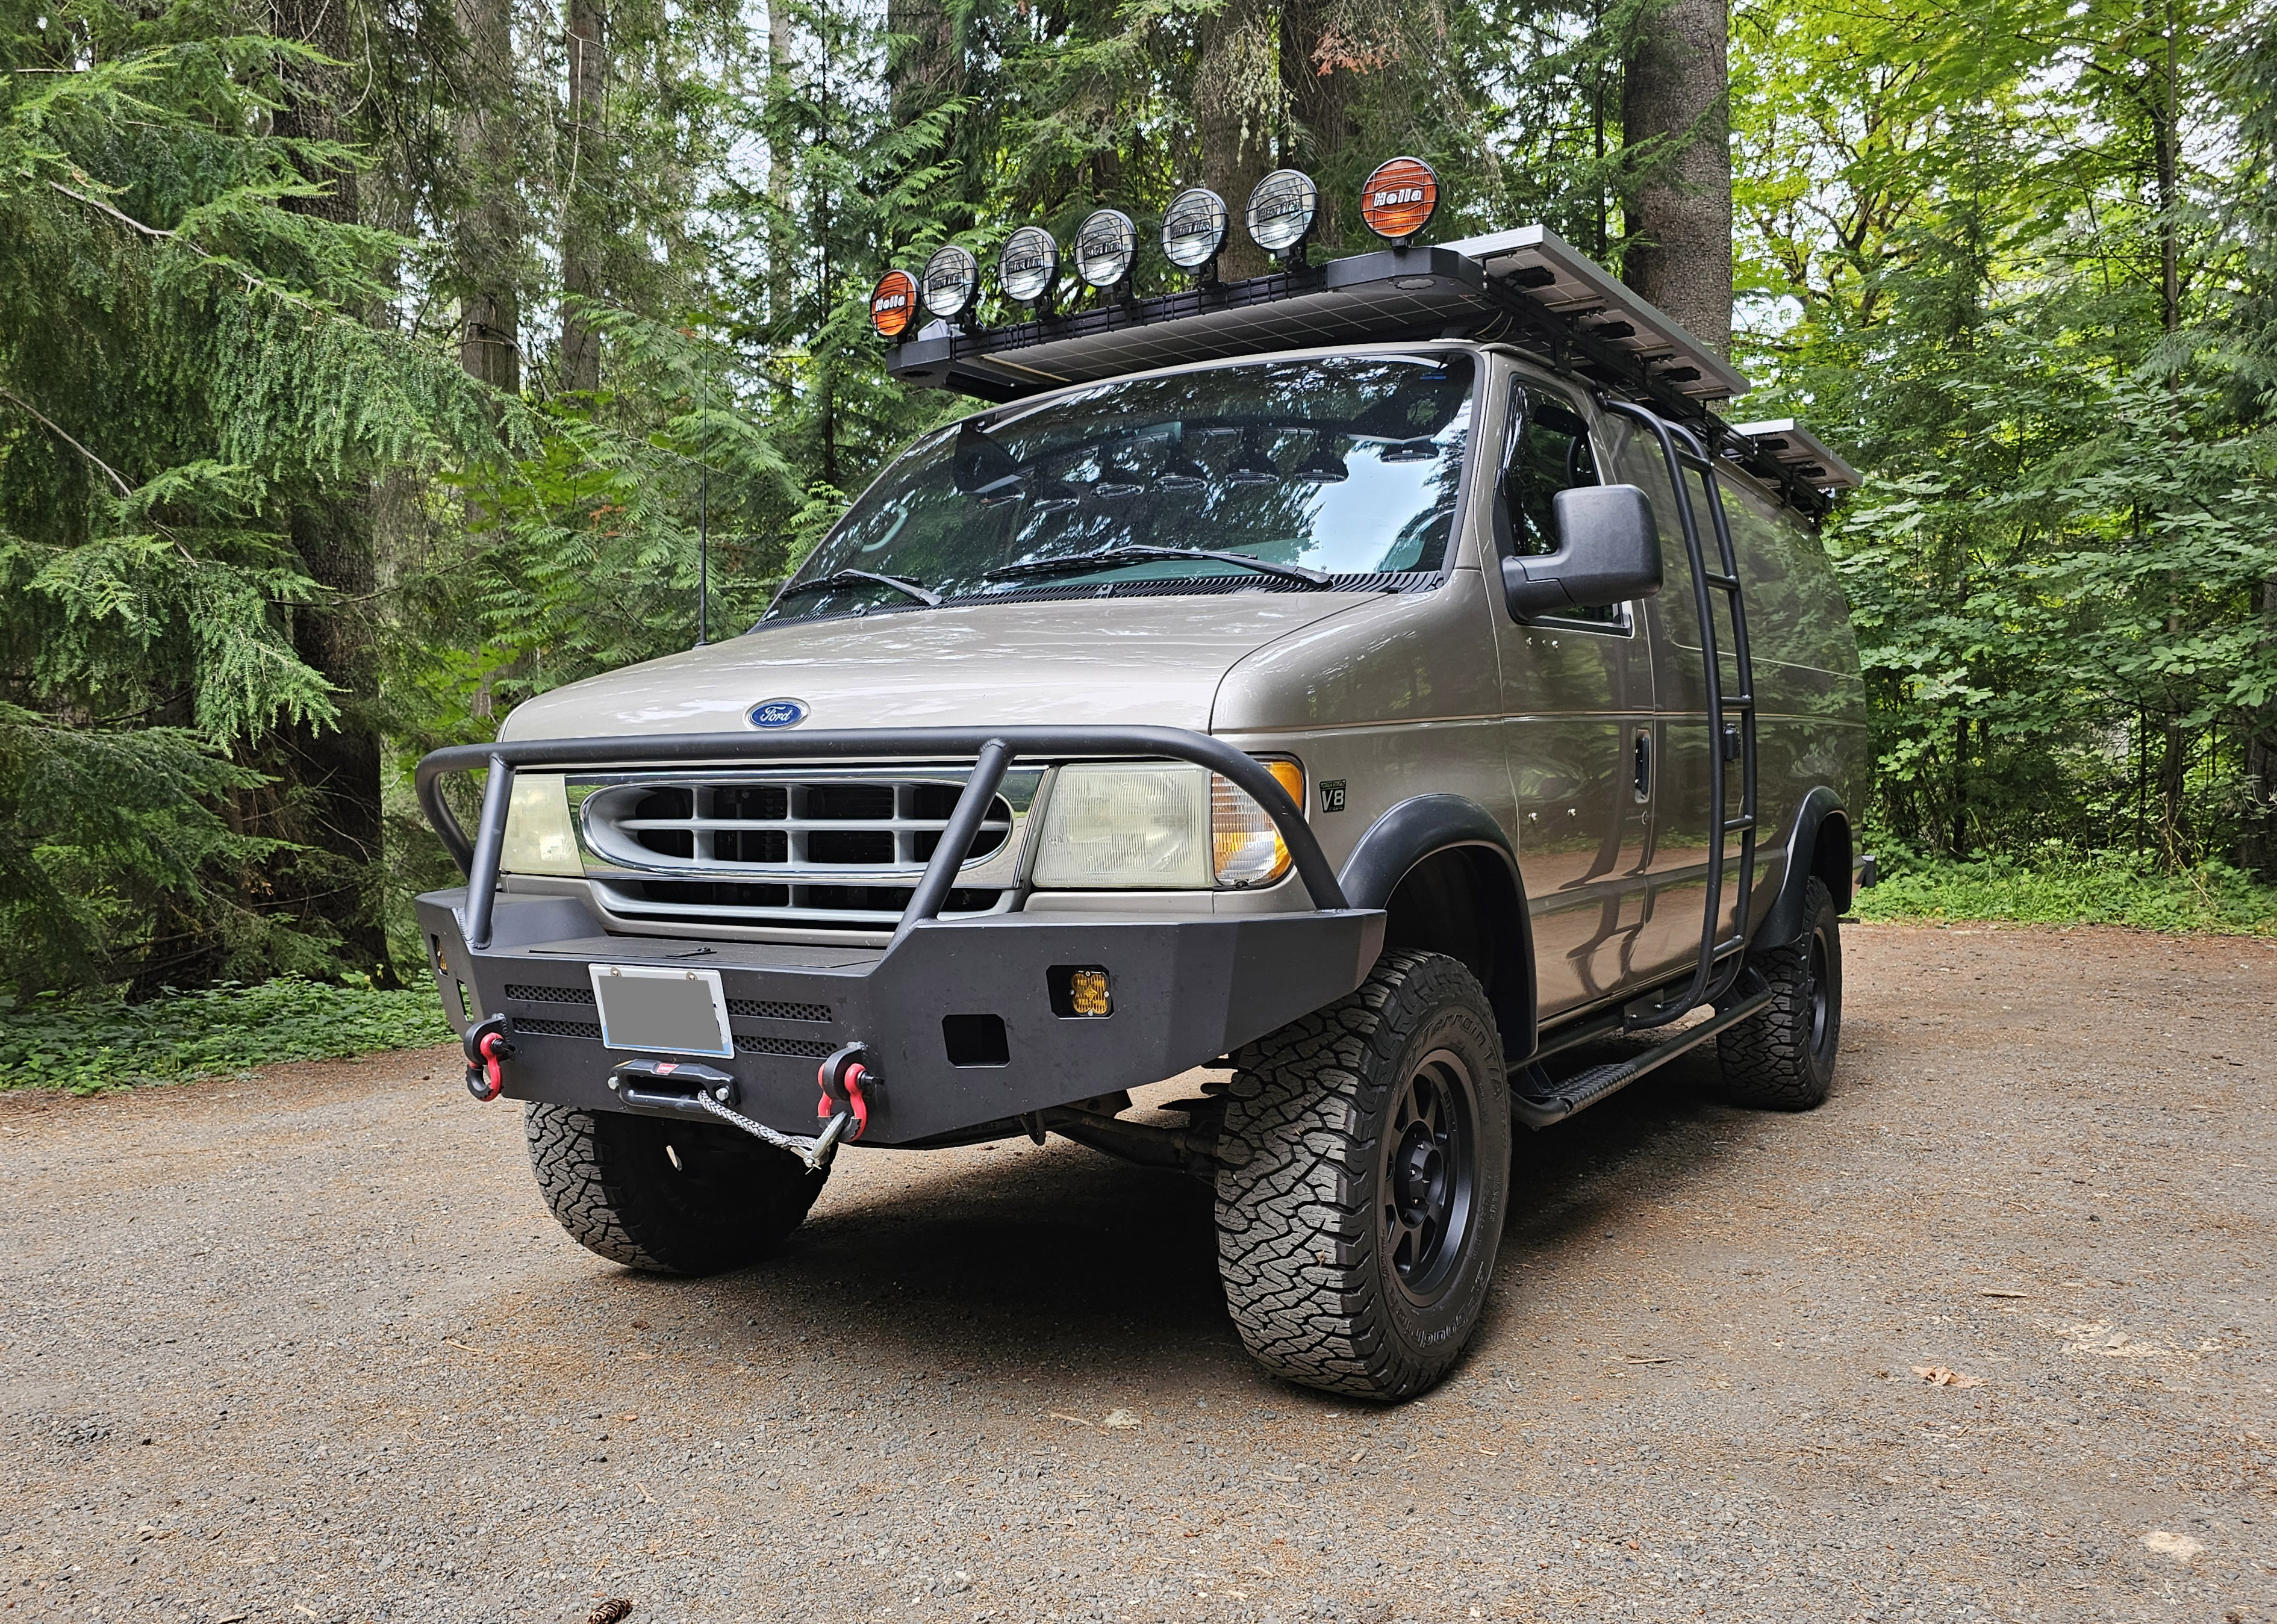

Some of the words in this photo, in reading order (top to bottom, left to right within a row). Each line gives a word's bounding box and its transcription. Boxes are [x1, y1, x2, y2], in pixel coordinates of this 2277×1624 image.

[1374, 188, 1422, 207] Hella
[875, 295, 905, 312] Hella
[760, 706, 793, 722] Ford
[1322, 789, 1344, 811] V8
